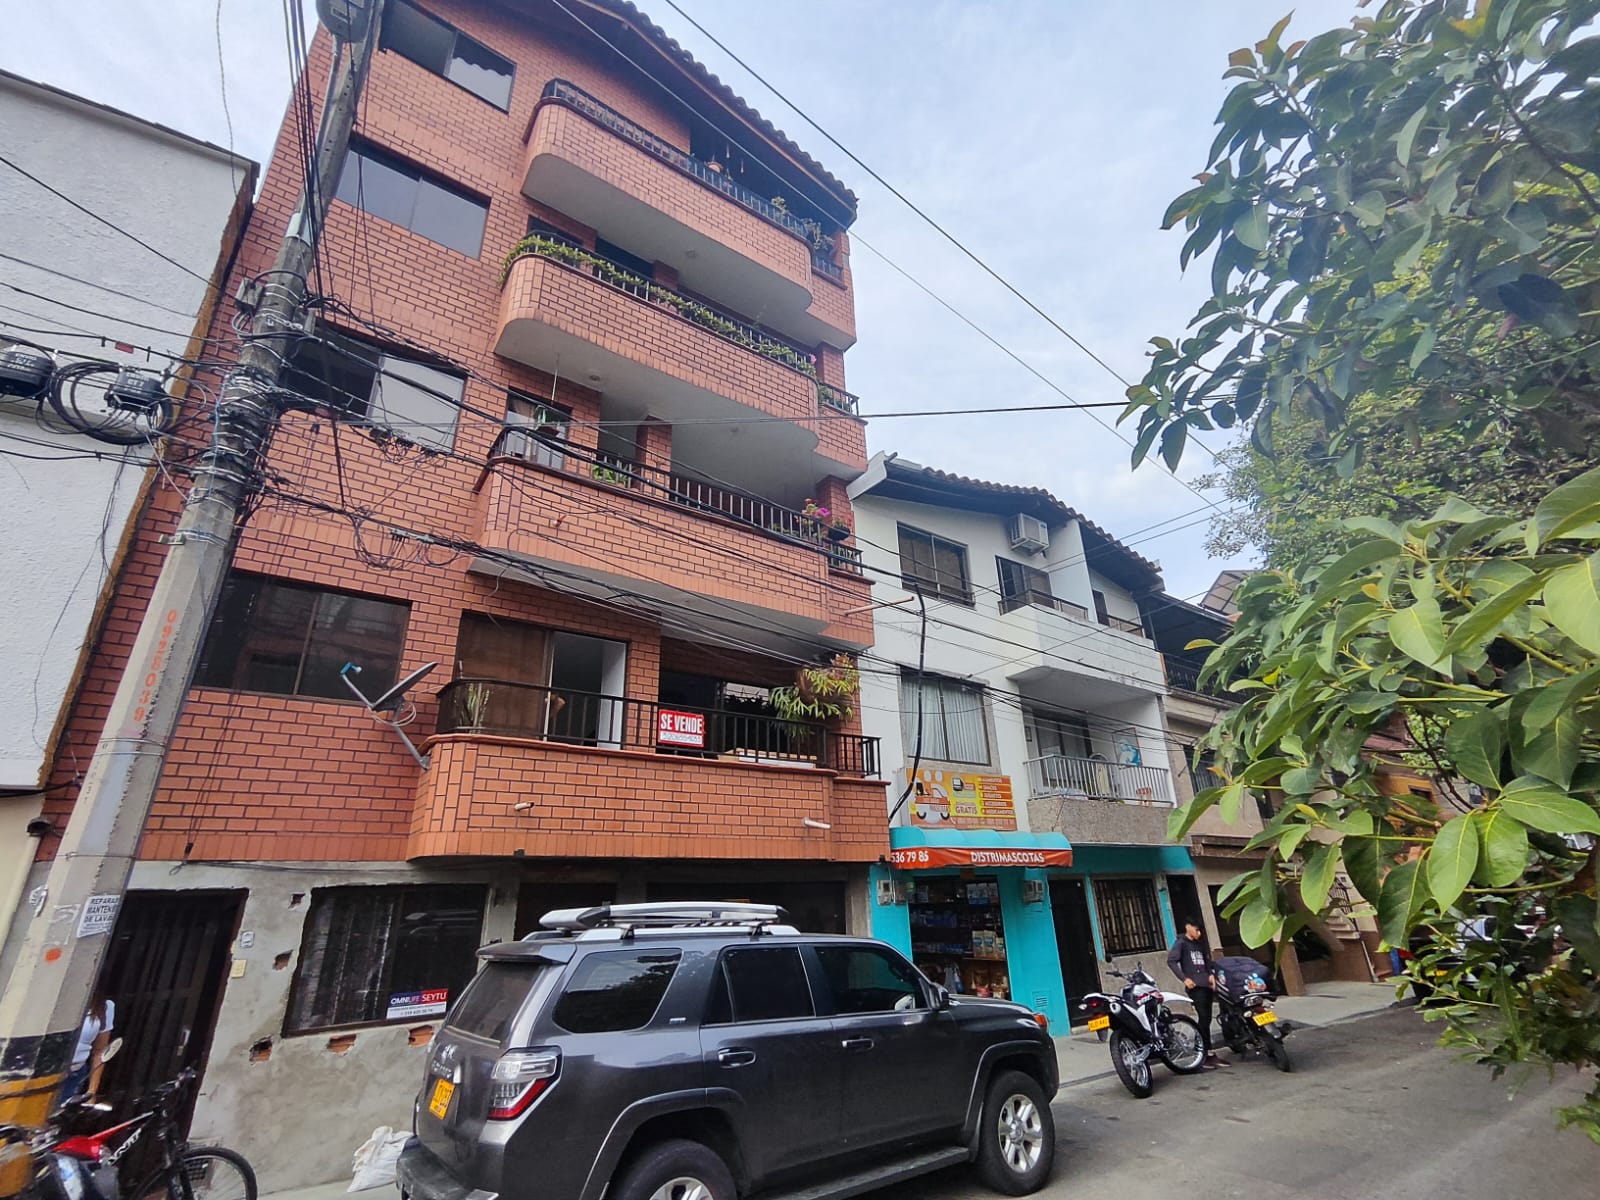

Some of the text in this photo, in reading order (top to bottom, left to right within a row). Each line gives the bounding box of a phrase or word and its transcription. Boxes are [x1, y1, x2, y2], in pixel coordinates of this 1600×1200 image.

[661, 713, 703, 734] SE VENDE
[906, 851, 917, 863] 79
[970, 851, 1045, 863] DISTRIMASCOTAS
